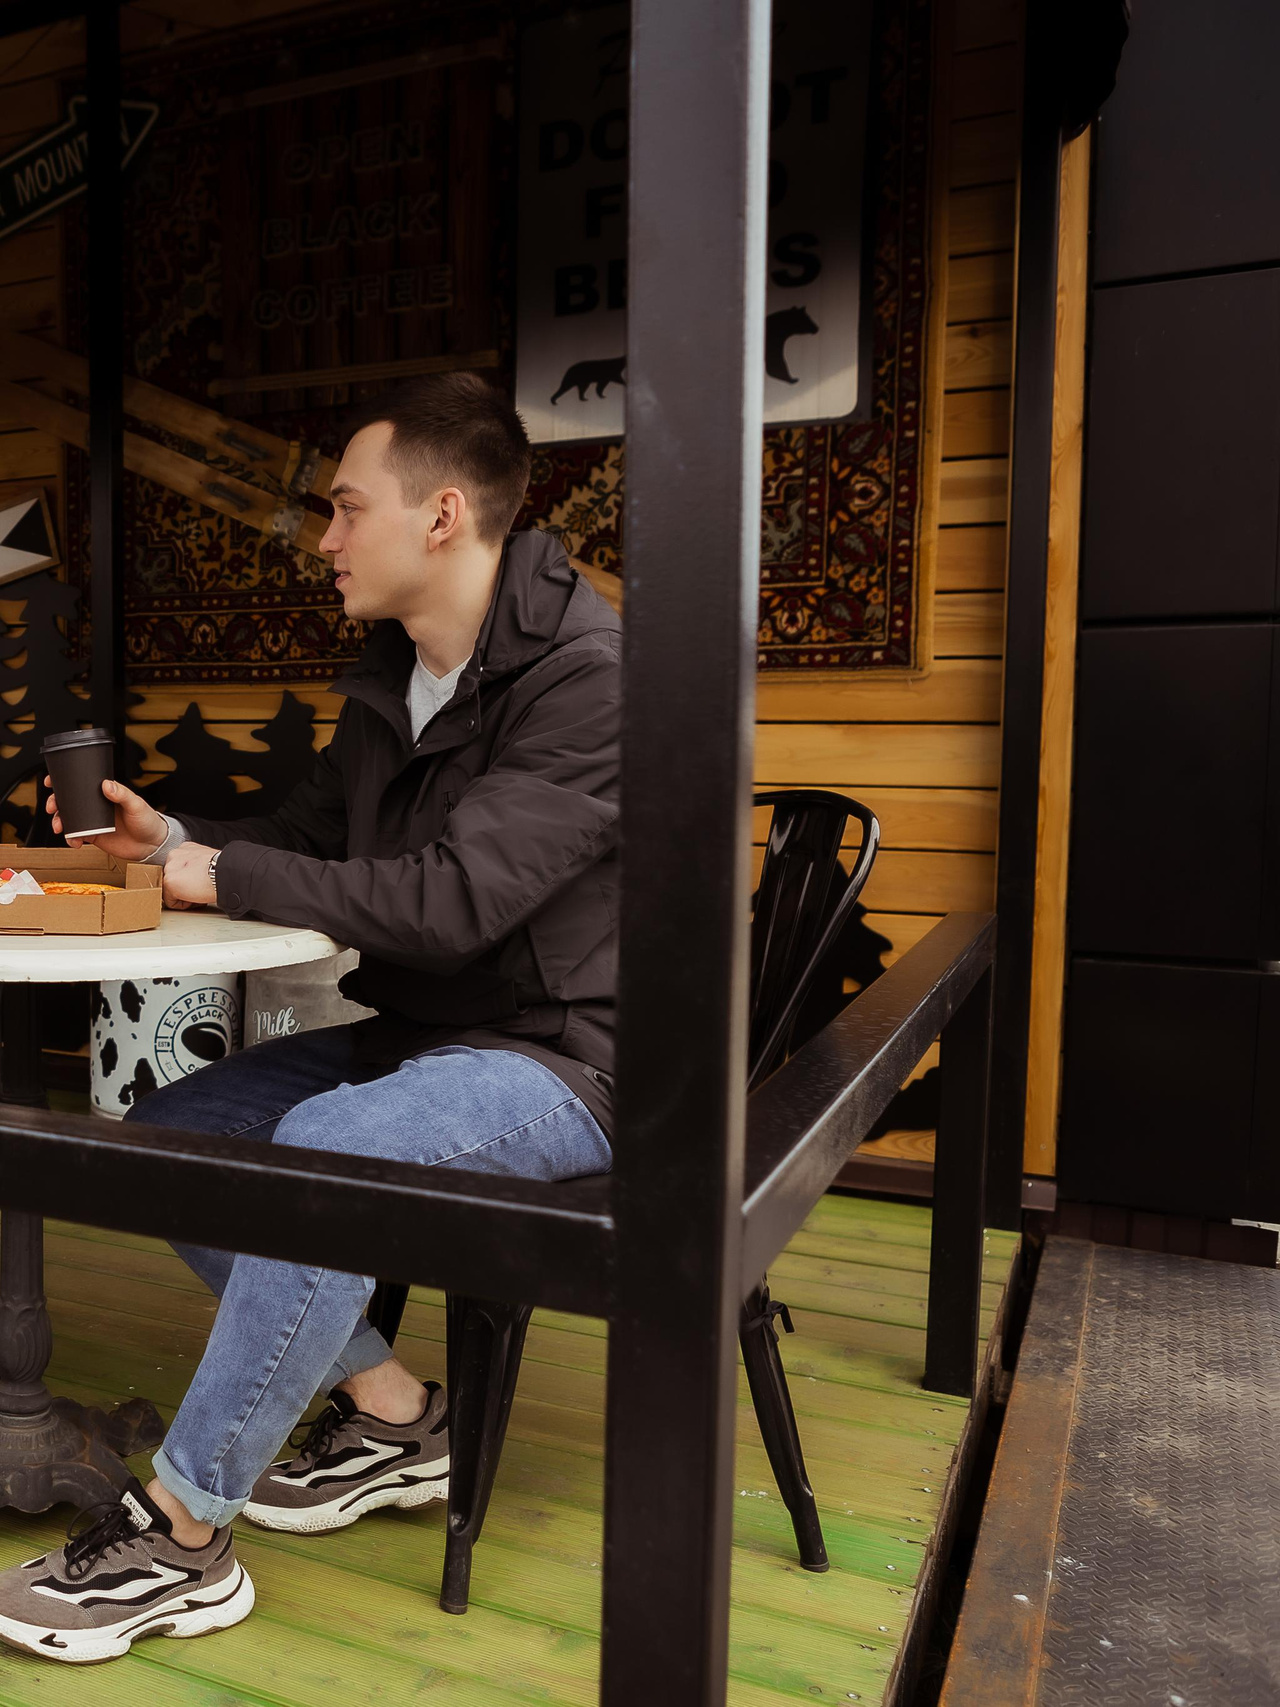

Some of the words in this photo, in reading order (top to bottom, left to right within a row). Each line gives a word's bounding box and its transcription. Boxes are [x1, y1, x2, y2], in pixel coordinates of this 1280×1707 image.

[281, 119, 424, 184] OPEN
[261, 191, 440, 260] BLACK
[252, 264, 453, 330] COFFEE
[163, 991, 239, 1029] ESPRESSO
[190, 1009, 224, 1023] BLACK
[253, 1006, 300, 1040] Milk
[126, 1497, 147, 1522] FASHION
